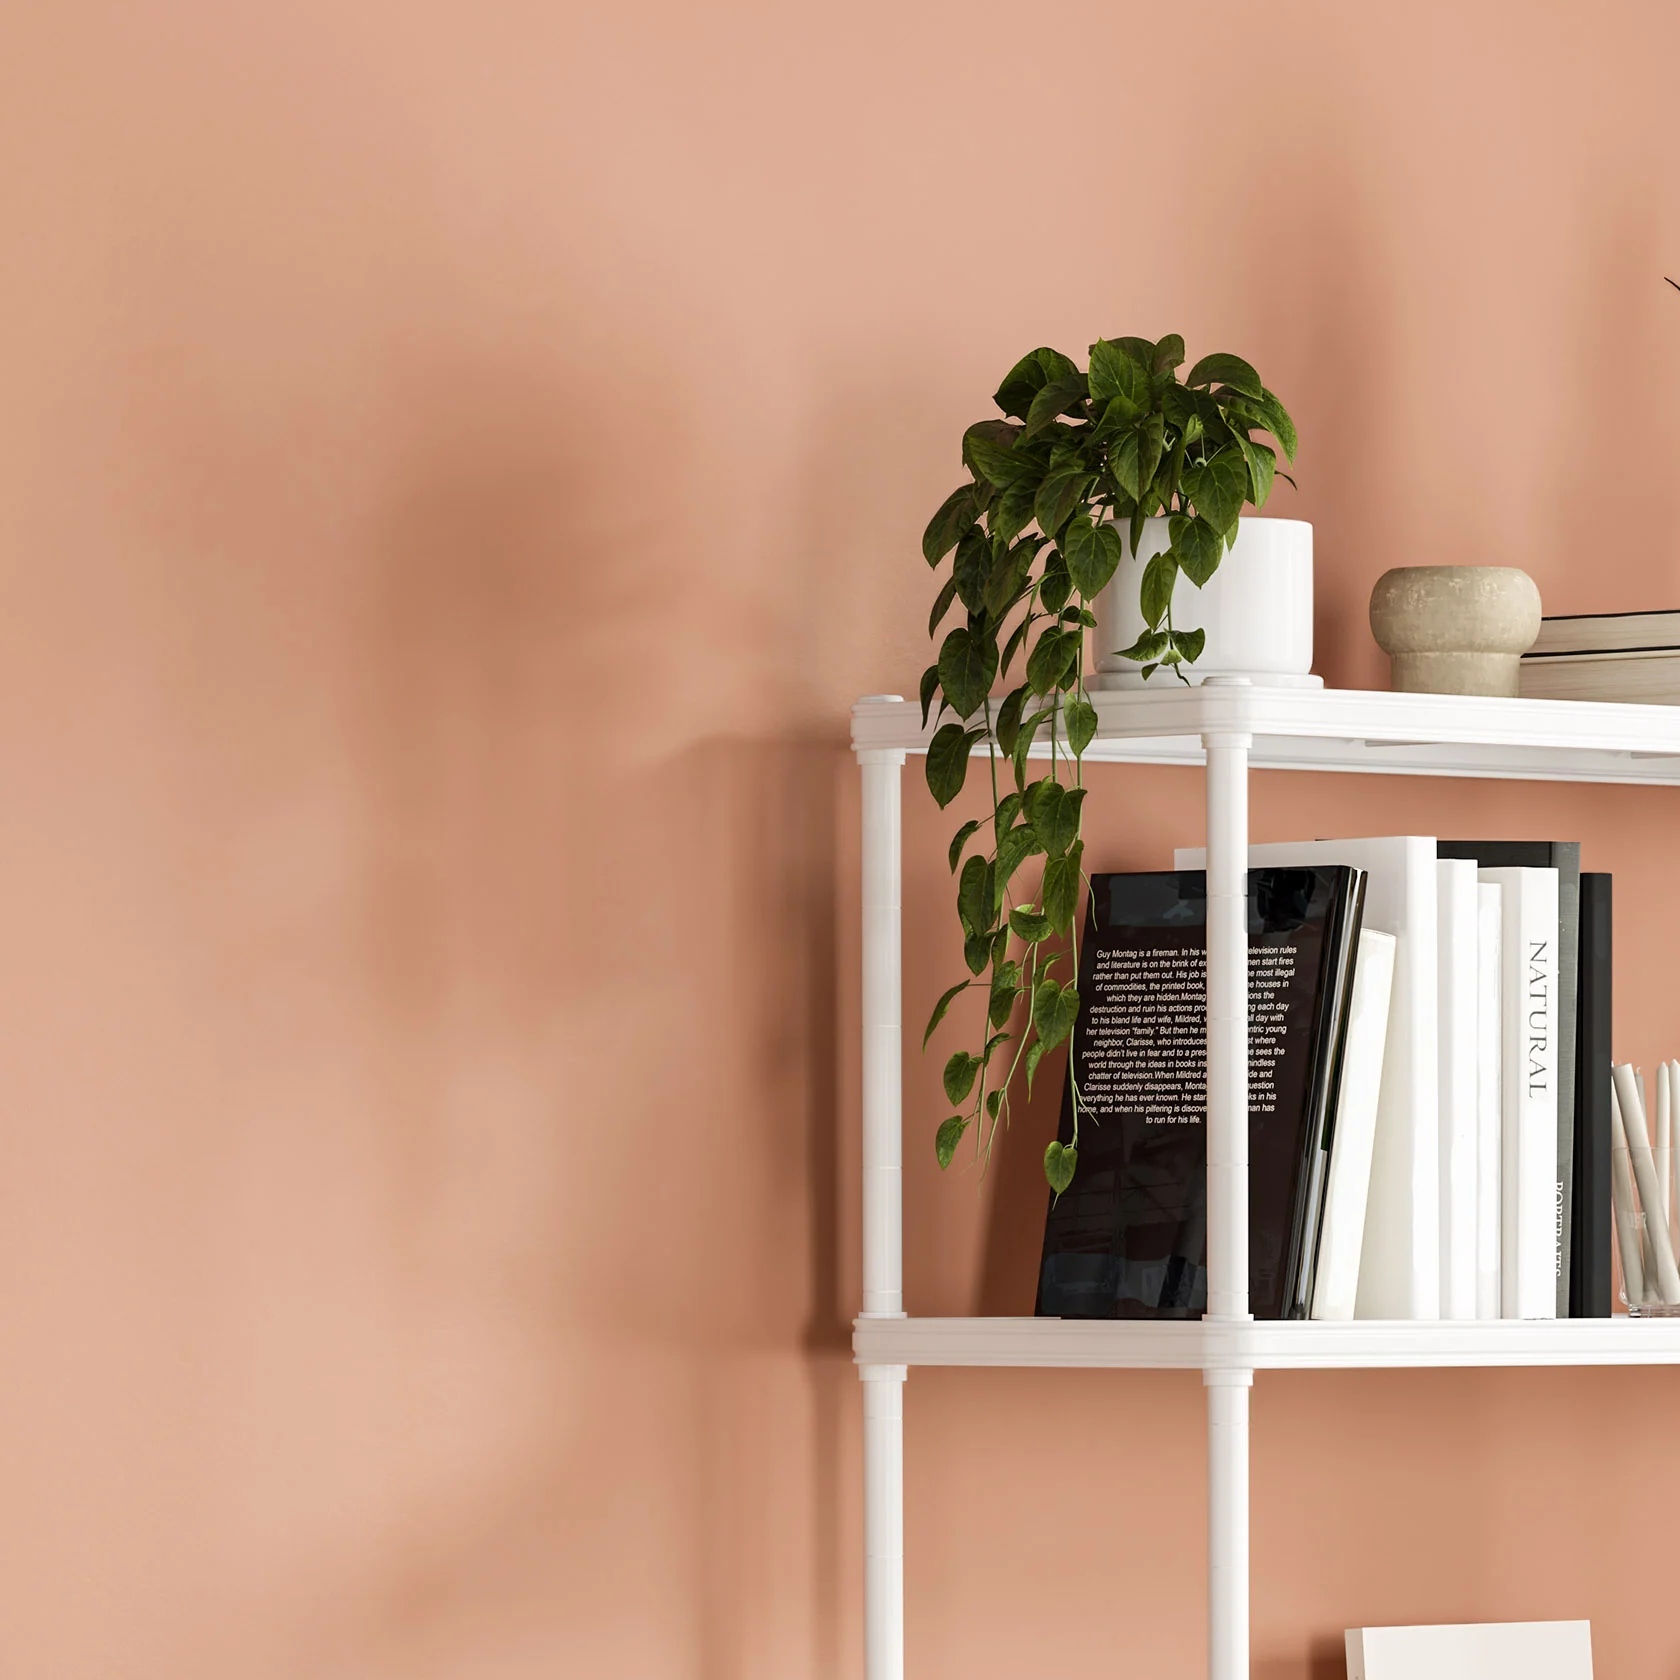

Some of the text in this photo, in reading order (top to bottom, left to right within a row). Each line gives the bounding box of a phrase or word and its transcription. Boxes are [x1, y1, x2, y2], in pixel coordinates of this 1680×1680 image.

[1112, 949, 1137, 959] Montag
[1152, 948, 1179, 957] fireman.
[1248, 946, 1278, 954] elevision
[1279, 946, 1297, 954] rules
[1111, 960, 1140, 968] literature
[1172, 959, 1188, 967] brink
[1278, 957, 1294, 965] fires
[1093, 971, 1112, 980] rather
[1114, 971, 1129, 979] than
[1143, 971, 1160, 979] them
[1256, 969, 1273, 977] most
[1274, 968, 1294, 978] illegal
[1104, 982, 1147, 992] commodities,
[1162, 981, 1185, 992] printed
[1186, 981, 1205, 991] book,
[1255, 979, 1281, 988] houses
[1106, 993, 1126, 1002] which
[1127, 993, 1142, 1003] they
[1090, 1004, 1126, 1013] destruction
[1257, 1002, 1274, 1010] each
[1111, 1016, 1130, 1024] bland
[1131, 1015, 1141, 1024] life
[1157, 1015, 1173, 1024] wife,
[1175, 1014, 1202, 1024] Mildred,
[1269, 1013, 1284, 1021] with
[1528, 940, 1547, 1098] NATURAL
[1099, 1026, 1130, 1035] television
[1172, 1026, 1188, 1034] then
[1265, 1026, 1287, 1034] young
[1094, 1038, 1124, 1048] neighbor,
[1126, 1037, 1155, 1047] Clarisse,
[1172, 1037, 1206, 1045] introduces
[1254, 1035, 1276, 1044] where
[1082, 1049, 1104, 1060] people
[1126, 1049, 1137, 1057] live
[1147, 1049, 1160, 1057] fear
[1191, 1050, 1206, 1058] pres
[1088, 1060, 1106, 1069] world
[1108, 1060, 1134, 1070] through
[1148, 1060, 1166, 1068] ideas
[1175, 1059, 1196, 1067] books
[1088, 1071, 1111, 1080] chatter
[1176, 1070, 1201, 1078] Mildred
[1084, 1083, 1111, 1091] Clarisse
[1112, 1082, 1142, 1093] suddenly
[1144, 1082, 1183, 1092] disappears,
[1185, 1081, 1206, 1090] Monta
[1155, 1093, 1179, 1101] known.
[1114, 1104, 1132, 1113] when
[1146, 1104, 1172, 1114] pilfering
[1181, 1103, 1206, 1112] discove
[1189, 1115, 1201, 1123] life.
